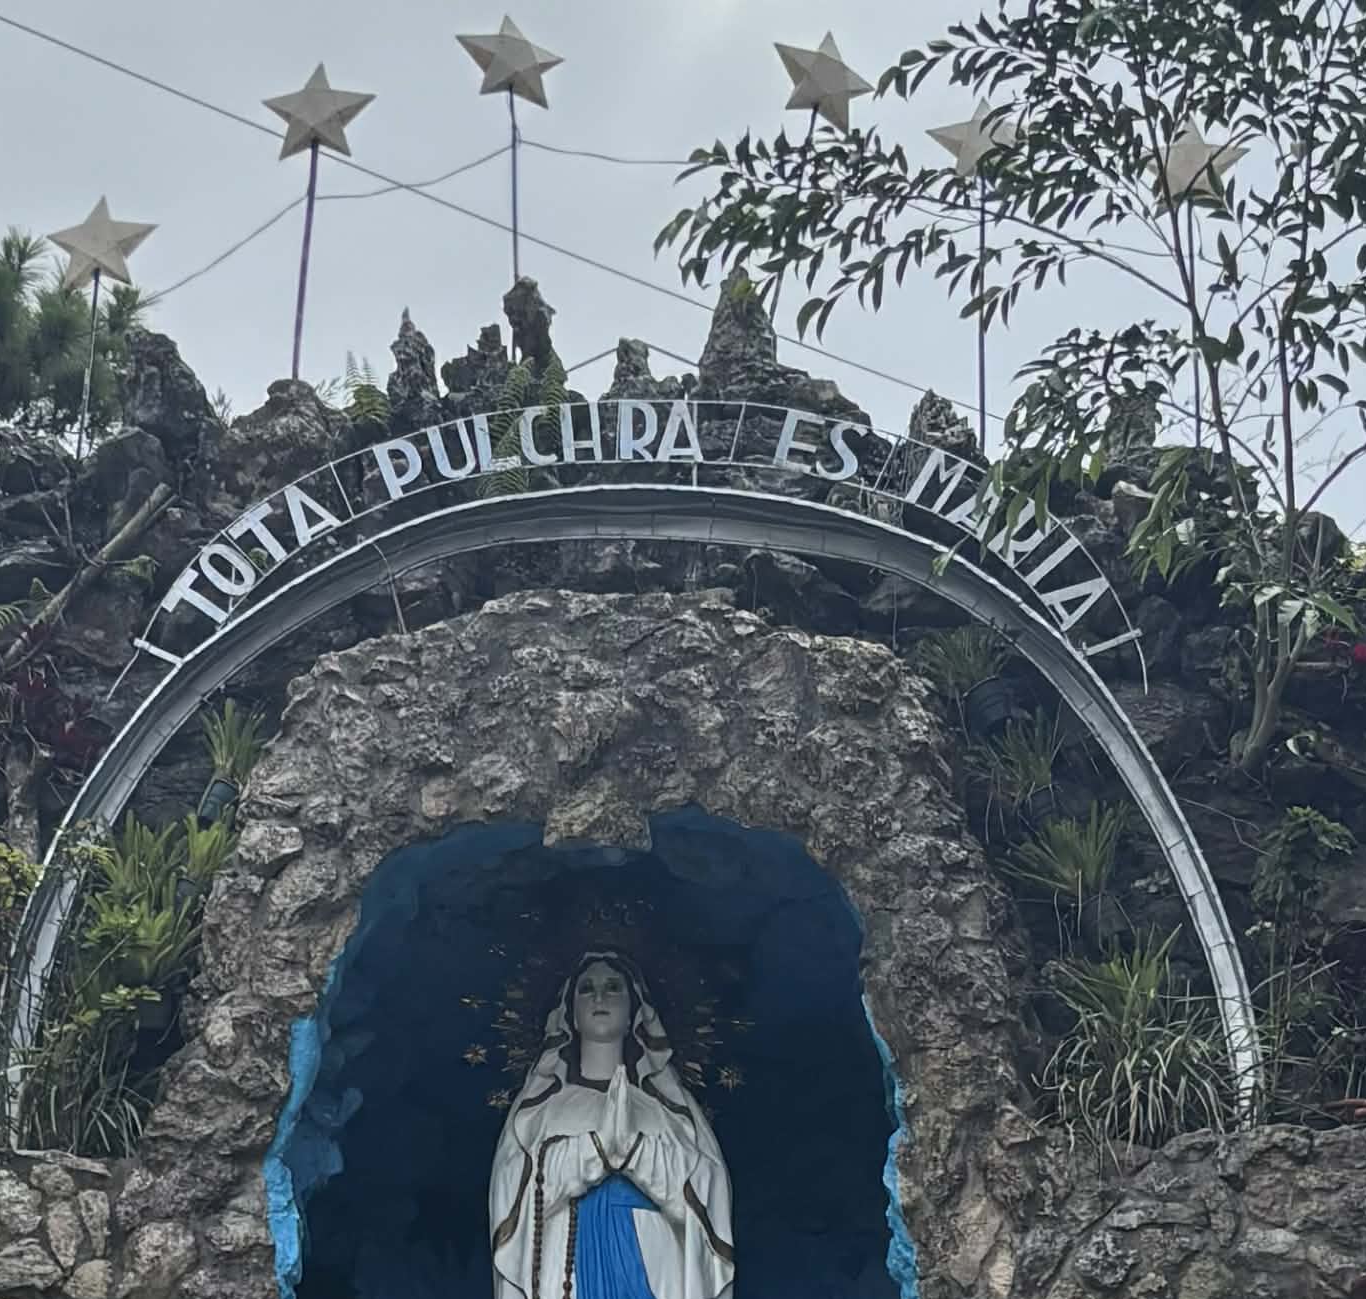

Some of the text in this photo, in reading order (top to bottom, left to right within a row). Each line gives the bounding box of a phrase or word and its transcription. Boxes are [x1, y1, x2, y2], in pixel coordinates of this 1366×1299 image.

[161, 485, 343, 626] TOTA
[372, 400, 703, 499] PULCHRA
[772, 408, 869, 481] ES
